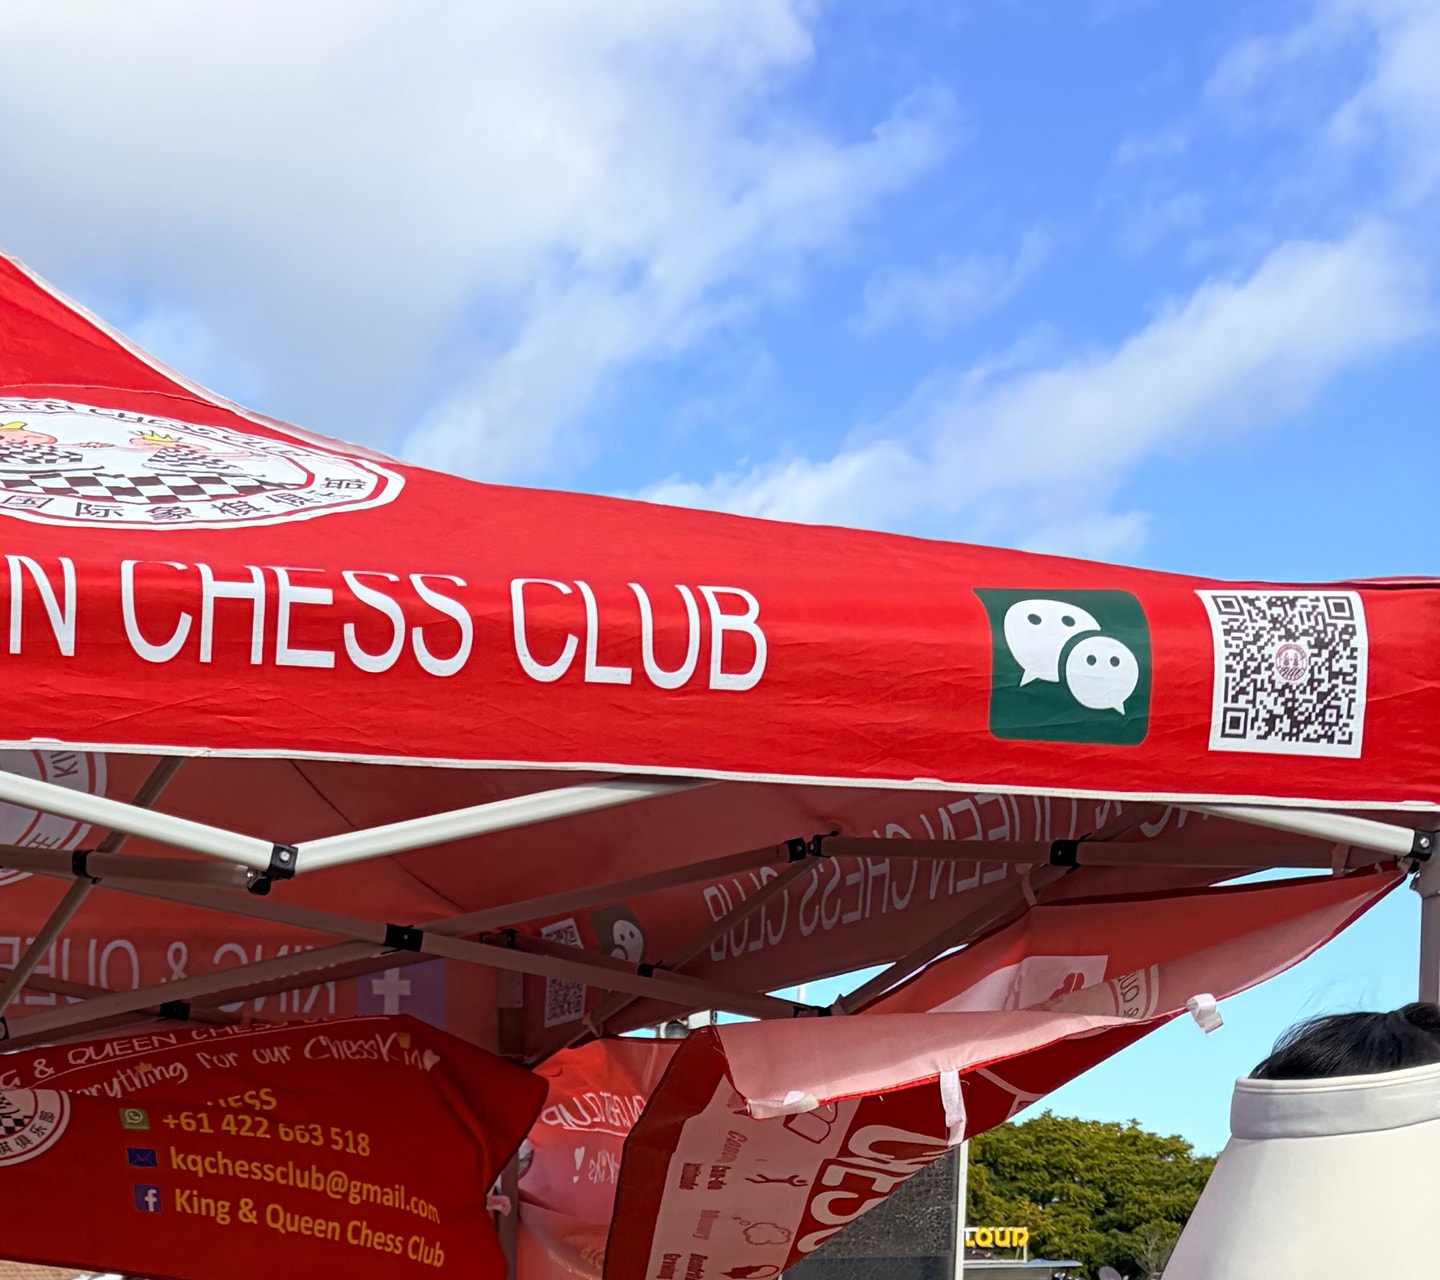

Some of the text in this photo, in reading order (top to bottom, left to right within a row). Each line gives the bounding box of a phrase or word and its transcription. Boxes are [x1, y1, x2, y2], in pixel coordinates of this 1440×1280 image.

[121, 558, 474, 678] CHESS
[511, 577, 766, 692] CLUB
[34, 1058, 56, 1080] &
[251, 1044, 292, 1066] our
[163, 1111, 371, 1157] +61 422 663 518
[169, 1146, 441, 1224] kqchessclub@gmail.com
[174, 1188, 446, 1268] King & Queen Chess Club
